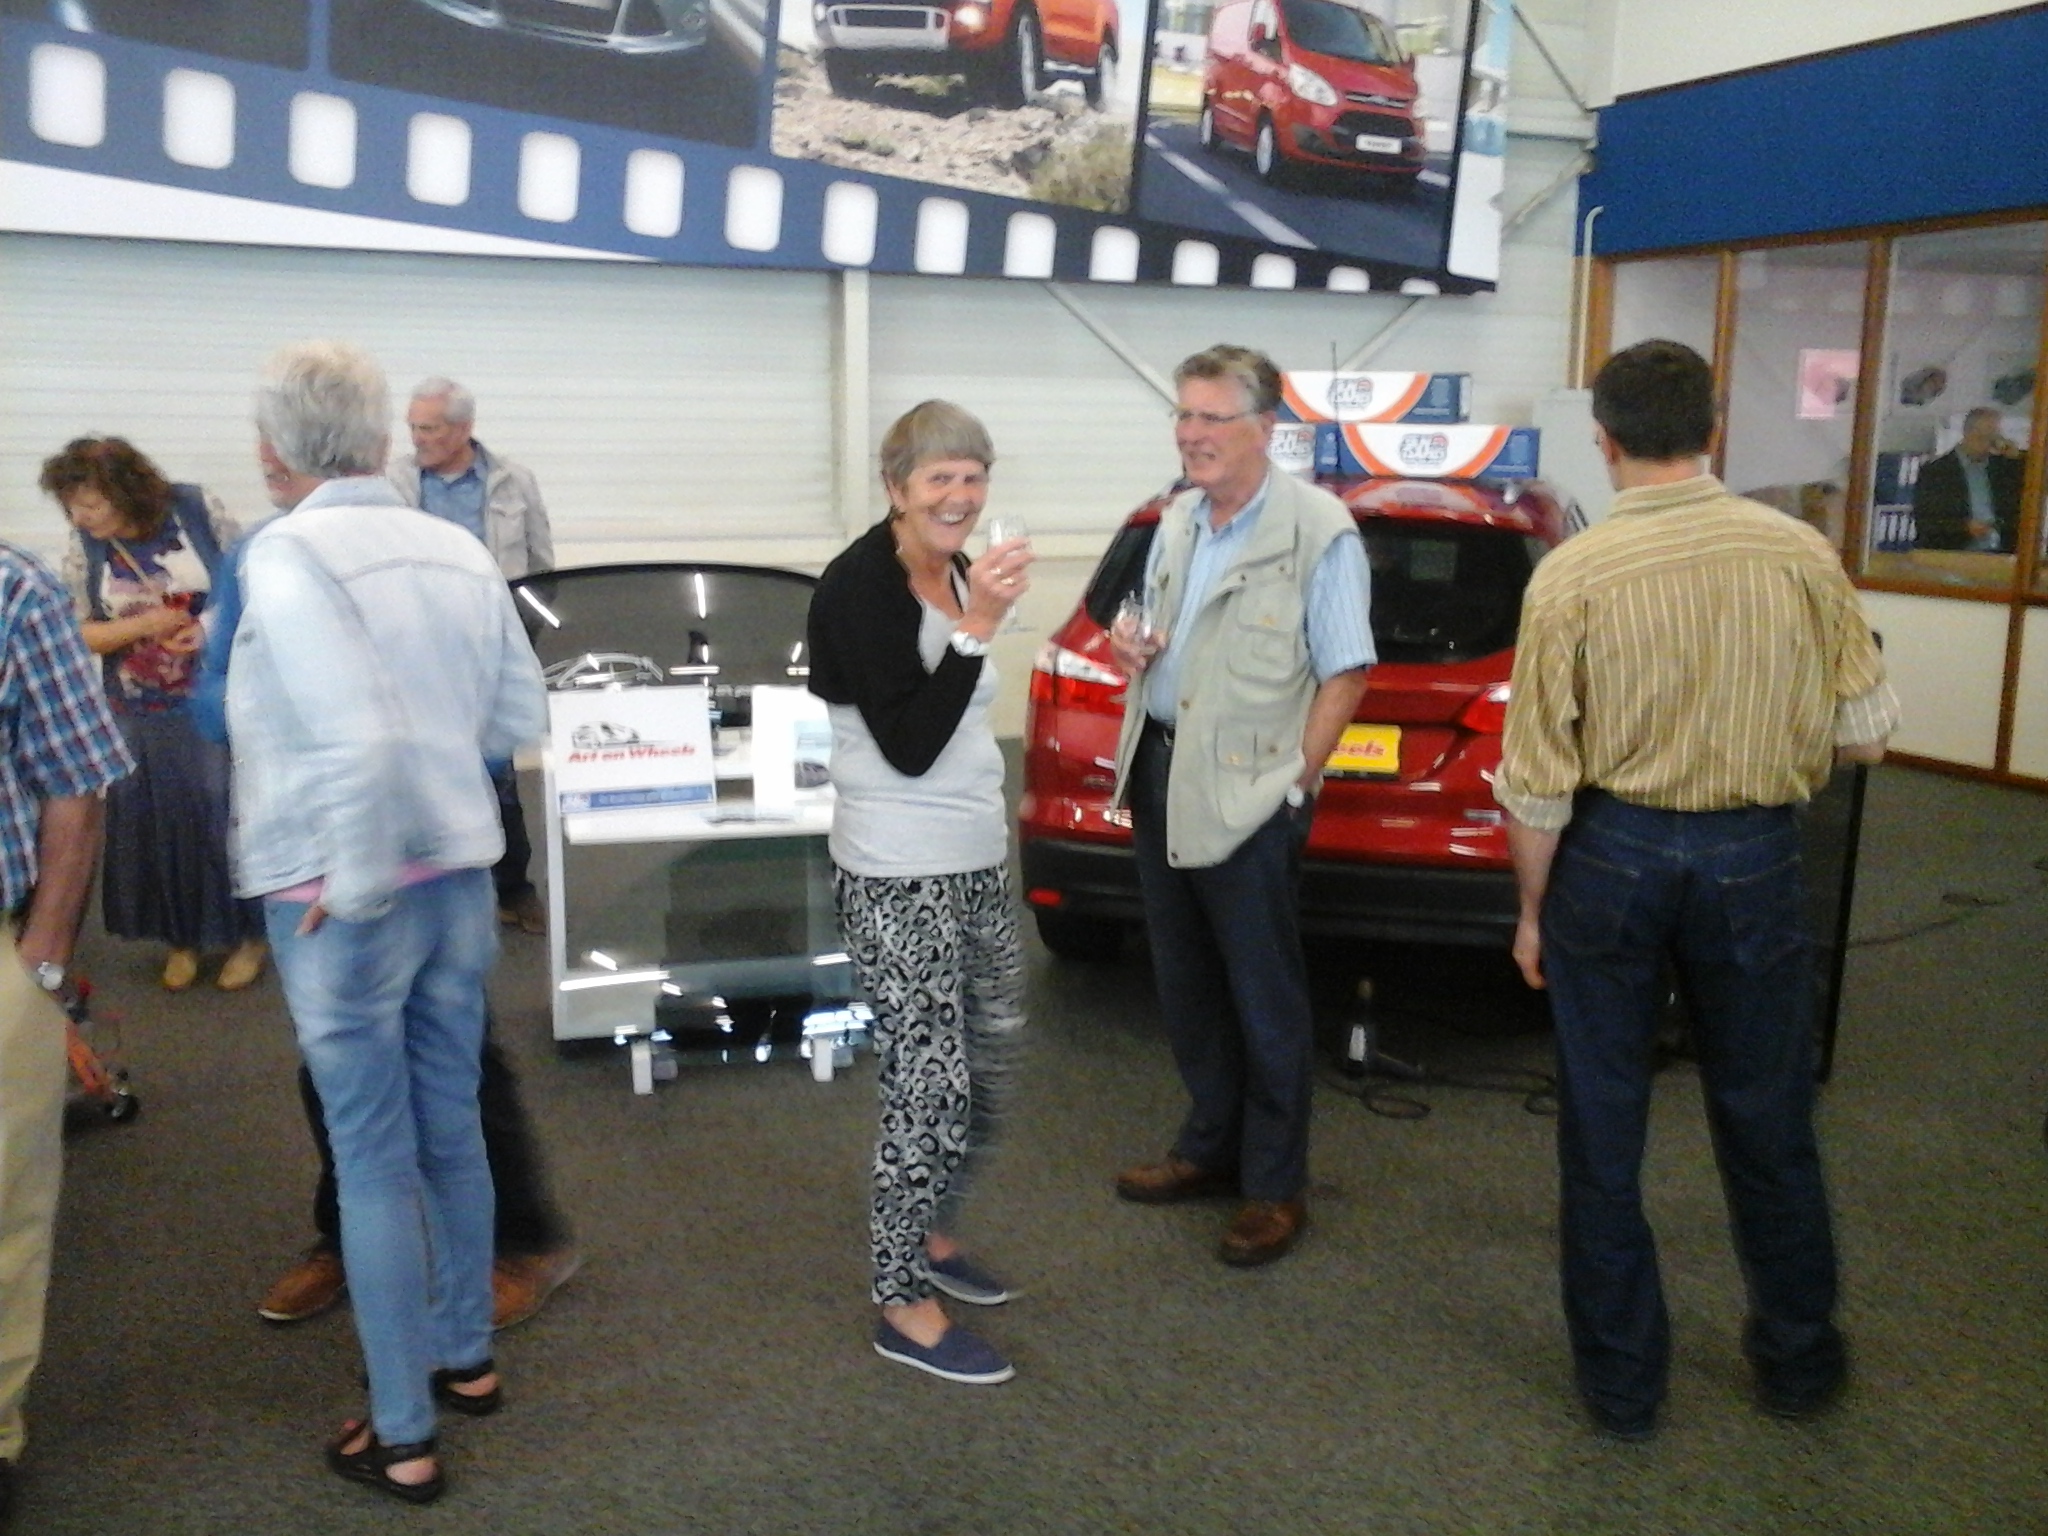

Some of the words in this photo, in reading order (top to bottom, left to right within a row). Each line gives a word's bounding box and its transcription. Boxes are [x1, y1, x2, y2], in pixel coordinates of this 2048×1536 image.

[567, 750, 597, 764] Art
[601, 750, 626, 761] on
[629, 744, 695, 759] Wheels
